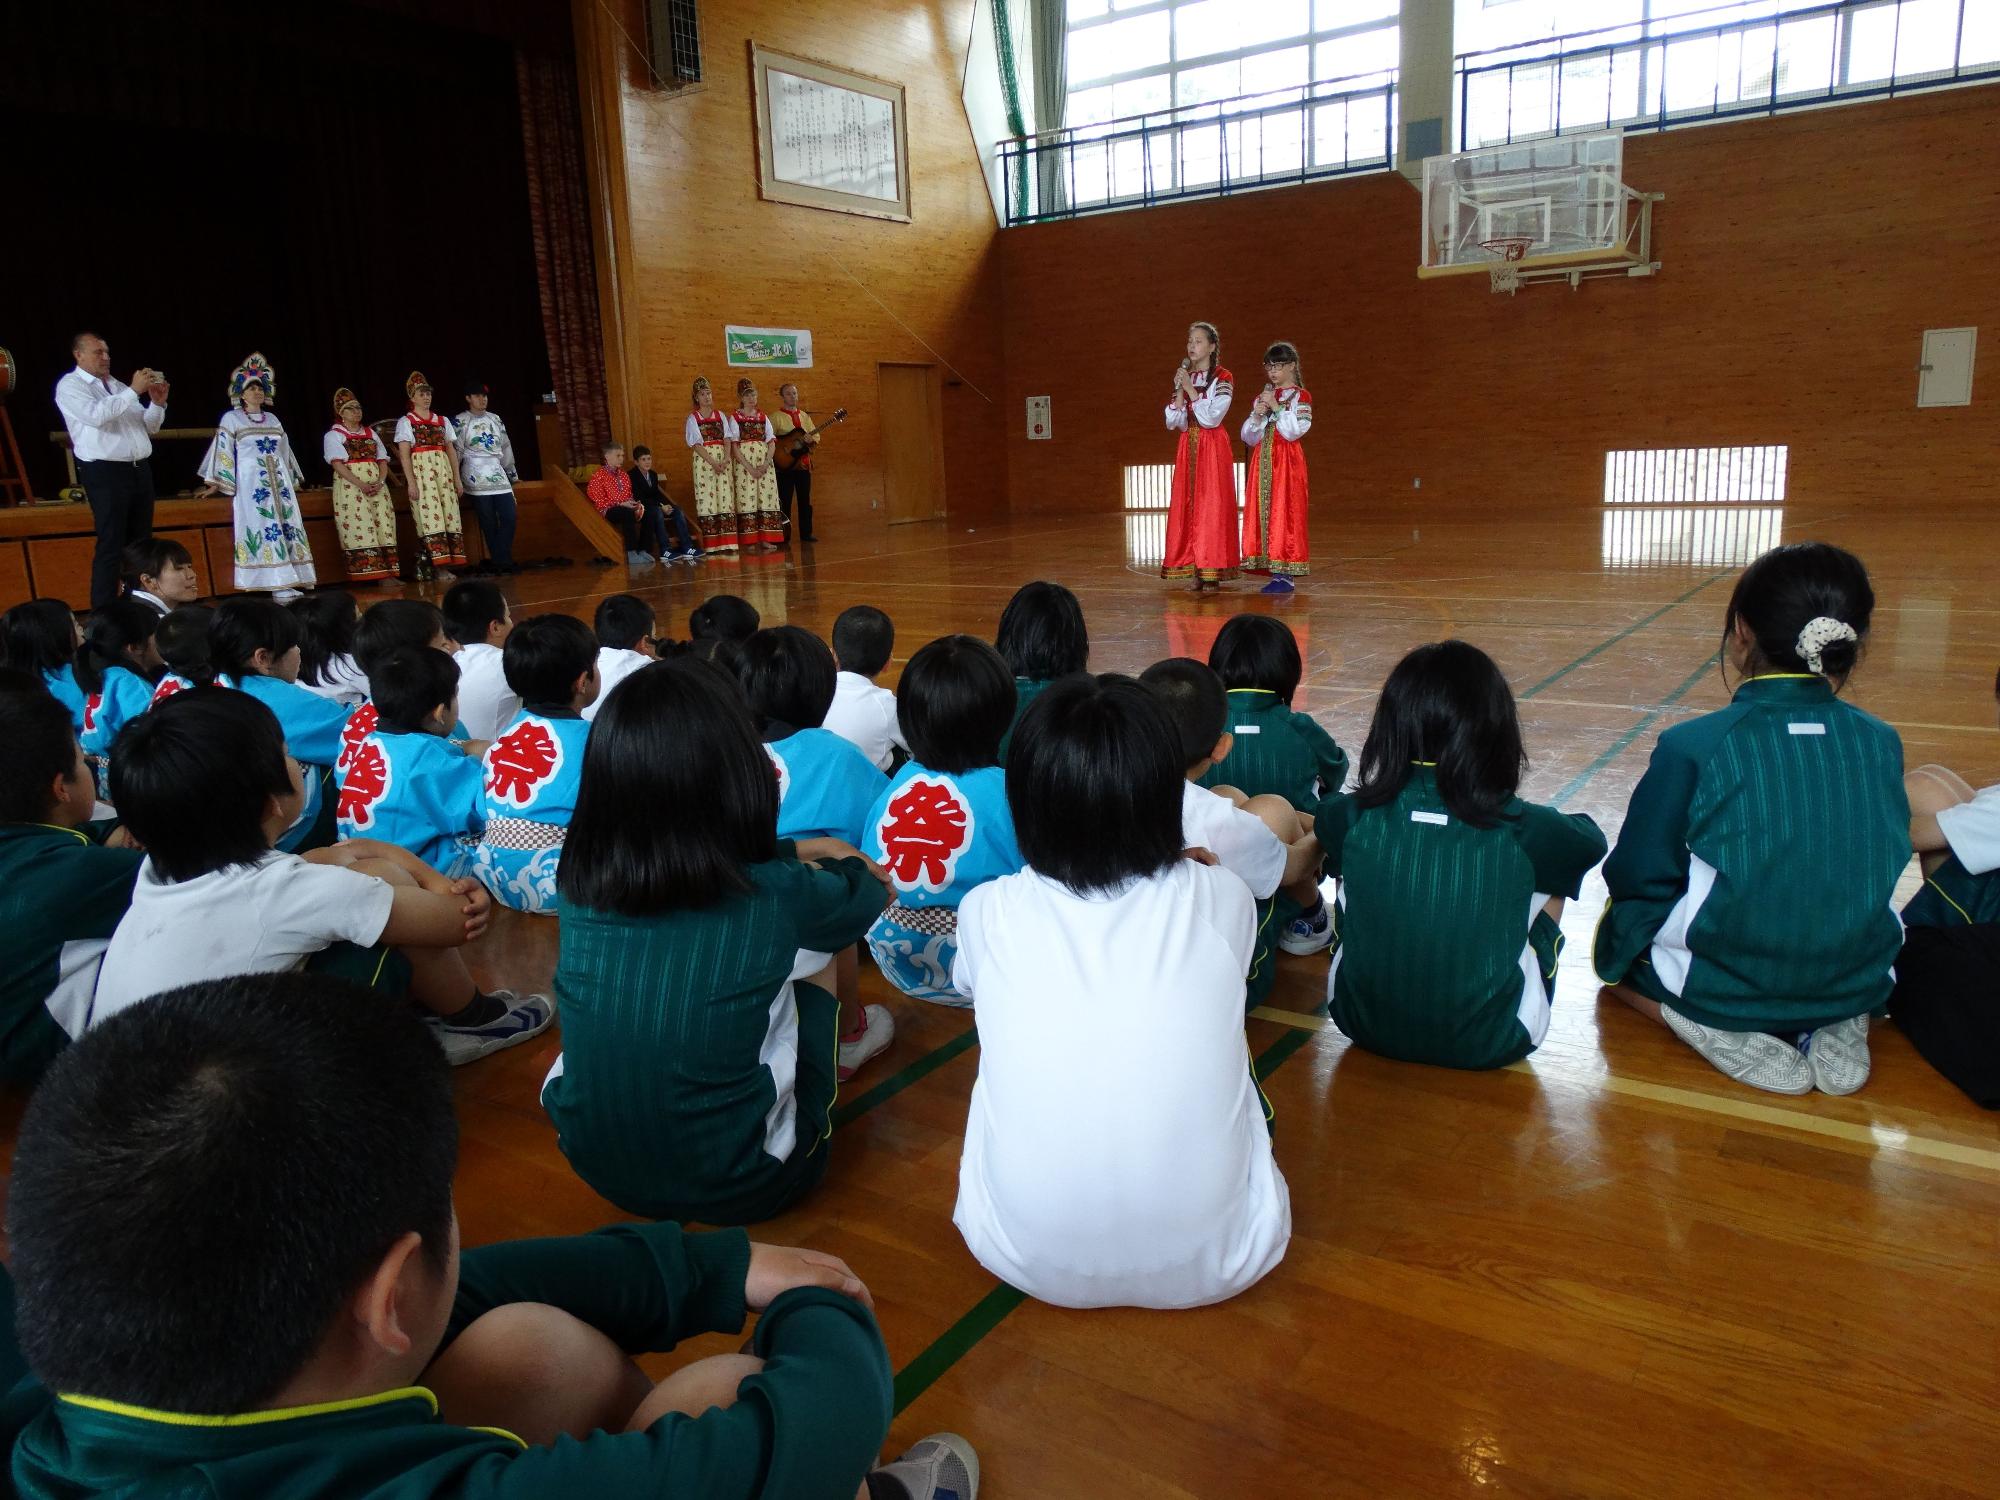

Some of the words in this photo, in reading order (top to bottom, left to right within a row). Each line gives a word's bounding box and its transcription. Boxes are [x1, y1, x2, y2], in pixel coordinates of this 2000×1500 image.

[336, 742, 387, 825] 祭
[486, 721, 557, 803] 祭
[882, 781, 967, 886] 祭
